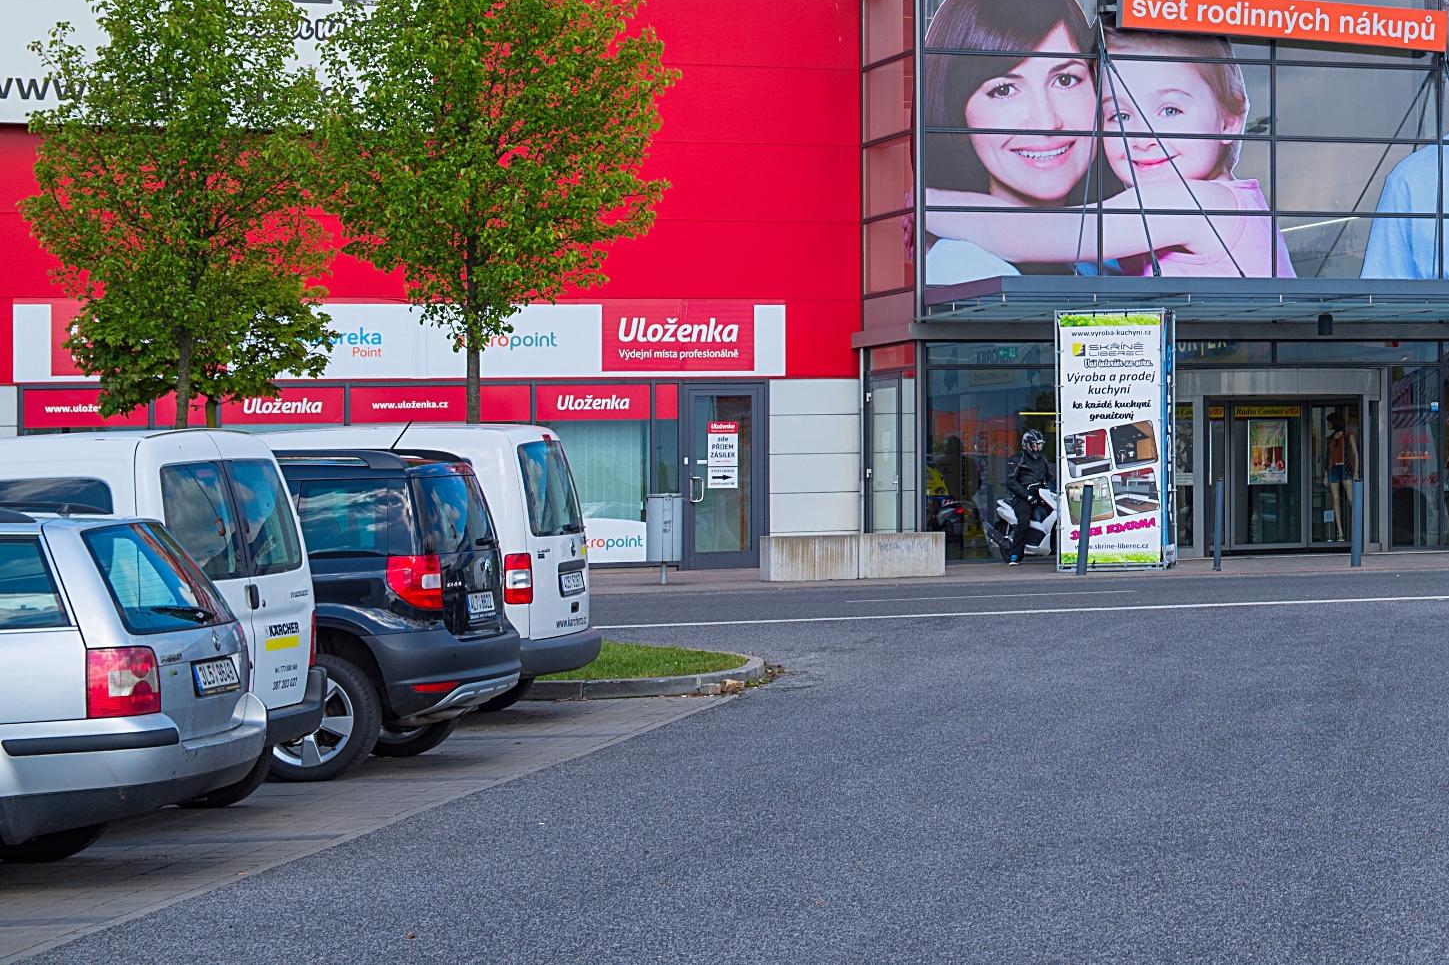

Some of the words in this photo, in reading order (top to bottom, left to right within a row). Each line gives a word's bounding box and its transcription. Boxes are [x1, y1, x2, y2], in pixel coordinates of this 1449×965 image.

[1196, 1, 1331, 34] rodinných
[1339, 11, 1437, 43] nákupů
[618, 317, 739, 343] Uloženka
[1071, 329, 1152, 337] www.vyroba-kuchyni.cz
[352, 346, 382, 358] Point
[618, 349, 652, 360] Výdejní
[653, 349, 677, 359] místa
[679, 348, 739, 360] profesionálně
[1067, 372, 1106, 384] Výroba
[1109, 374, 1116, 382] a
[1119, 371, 1156, 383] prodej
[1087, 384, 1131, 396] kuchyní
[243, 398, 322, 415] Uloženka
[372, 400, 448, 411] www.uloženka.cz
[557, 394, 631, 411] Uloženka
[1072, 401, 1083, 410] ke
[1085, 400, 1113, 410] každé
[1089, 411, 1135, 422] granitový
